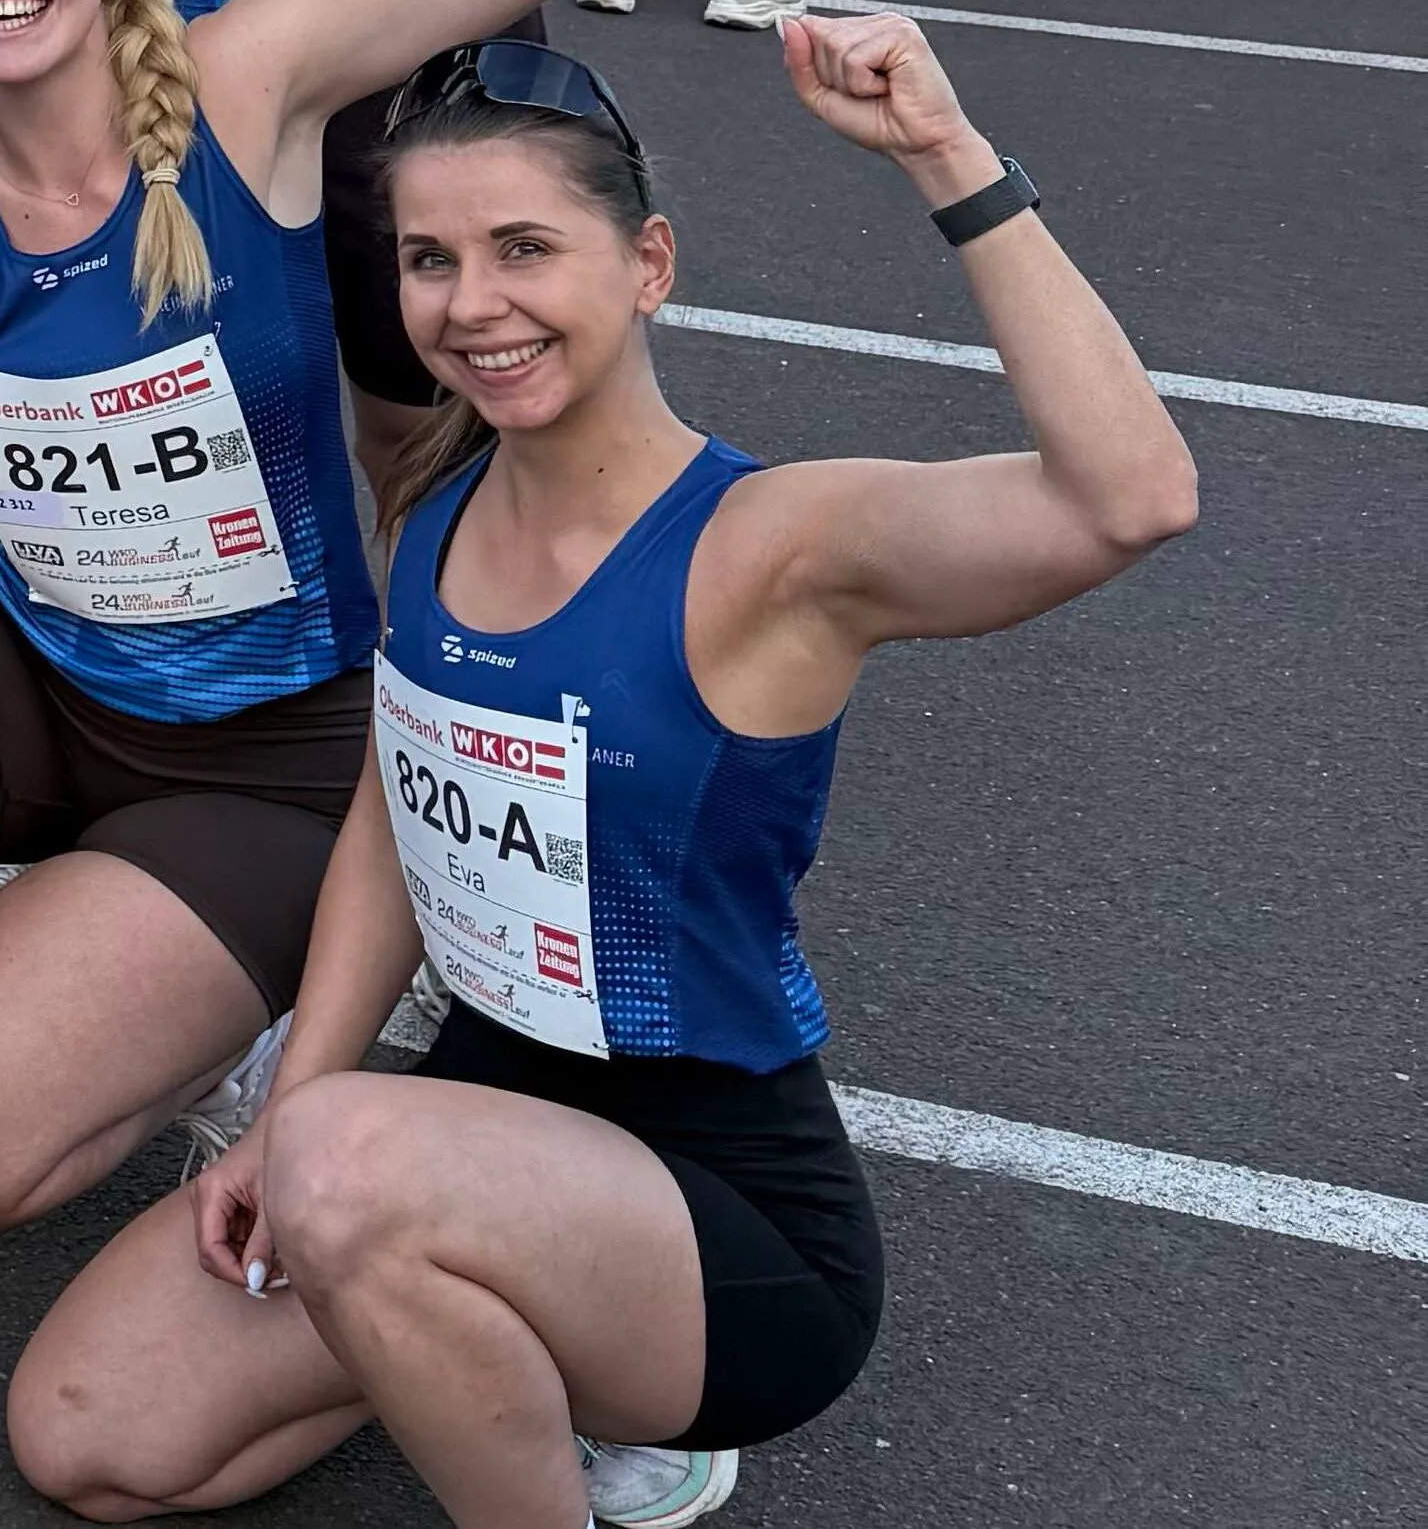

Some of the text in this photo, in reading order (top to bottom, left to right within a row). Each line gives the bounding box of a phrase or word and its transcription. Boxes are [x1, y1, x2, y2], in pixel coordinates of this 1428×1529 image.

[62, 253, 108, 279] spized
[92, 370, 181, 418] WKO
[3, 425, 210, 495] 821-B
[8, 497, 36, 512] 312
[69, 502, 171, 528] Teresa
[211, 514, 259, 537] Kronen
[215, 530, 263, 552] Zeitung
[467, 646, 517, 670] spized
[380, 683, 532, 774] Oberbank WKO
[395, 749, 548, 875] 820-A
[446, 851, 487, 895] Eva
